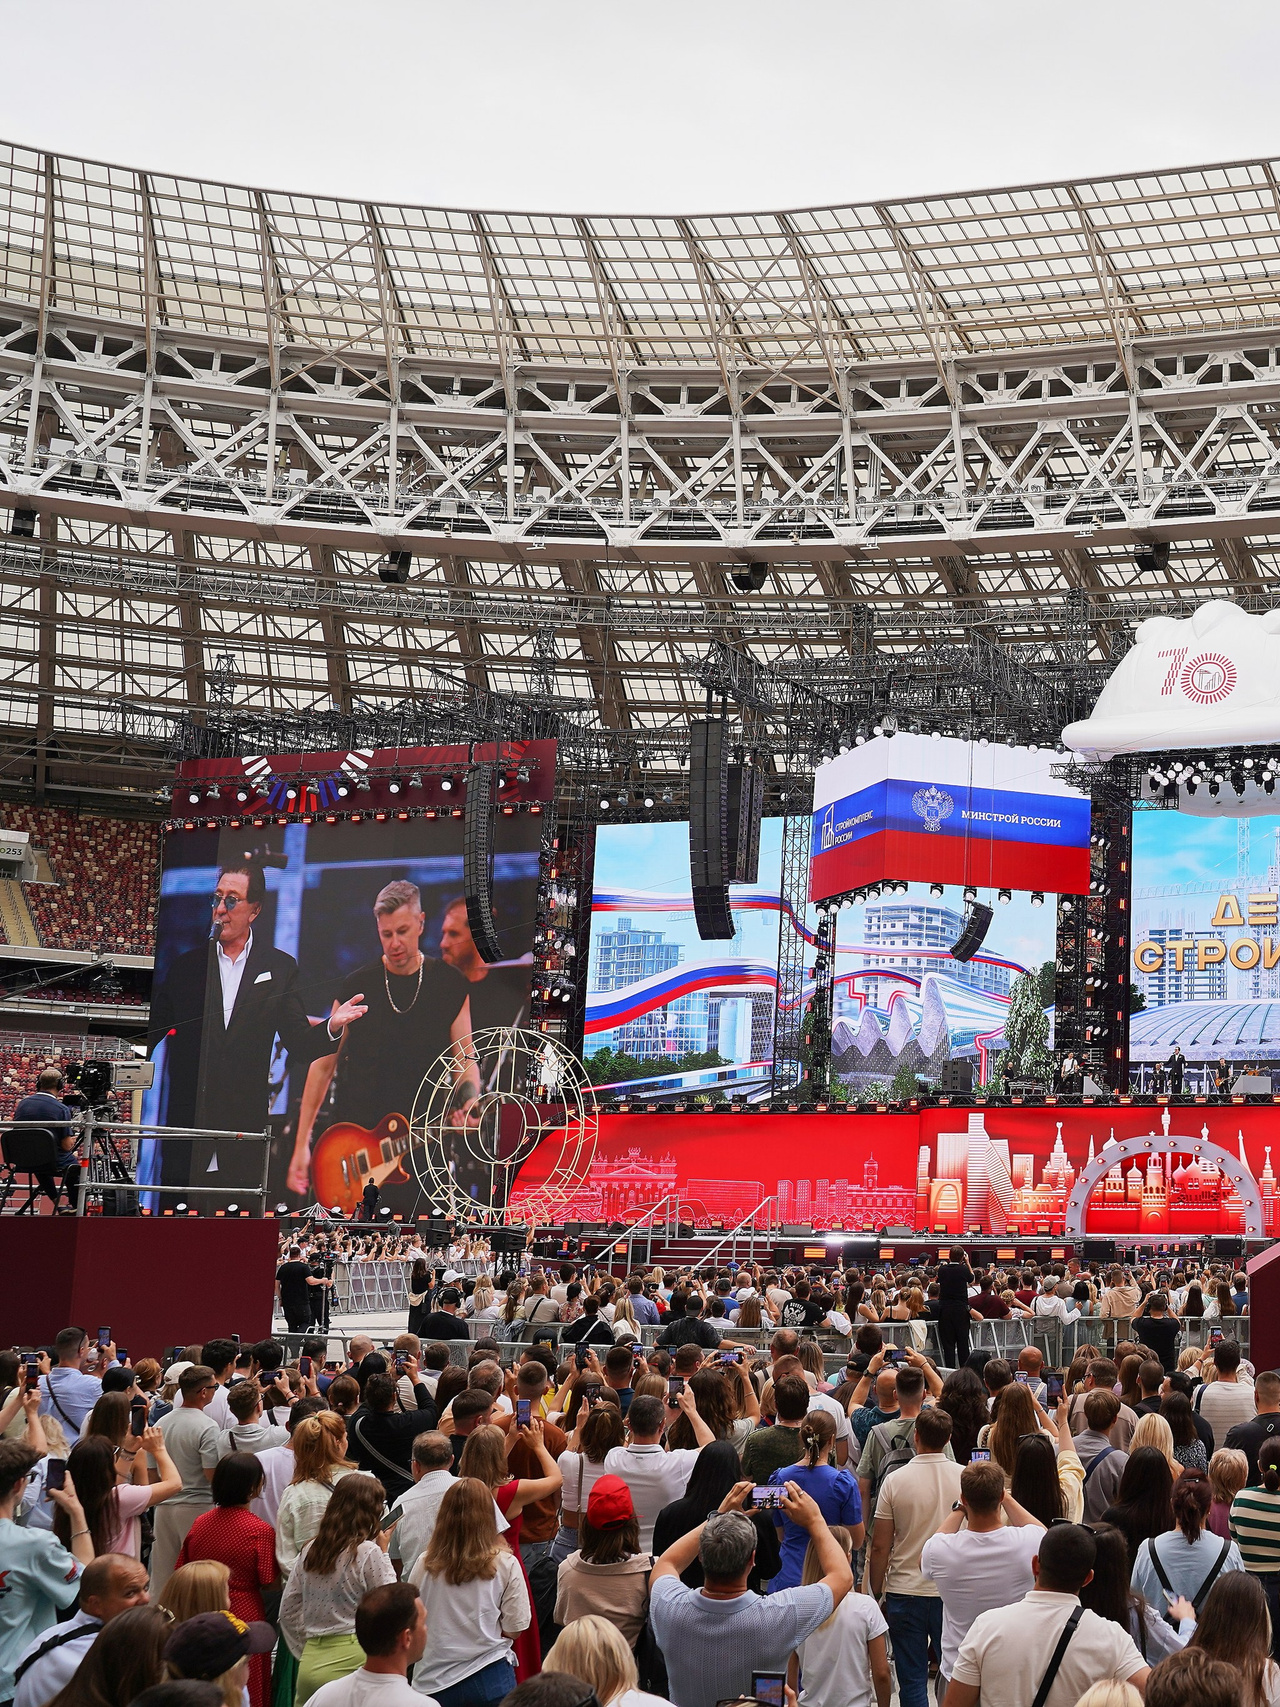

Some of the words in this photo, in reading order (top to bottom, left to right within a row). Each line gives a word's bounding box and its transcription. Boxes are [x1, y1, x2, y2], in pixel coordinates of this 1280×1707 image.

[961, 810, 1019, 824] МИНСТРОЙ
[1020, 816, 1061, 828] РОССИИ
[834, 830, 853, 845] РОССИИ
